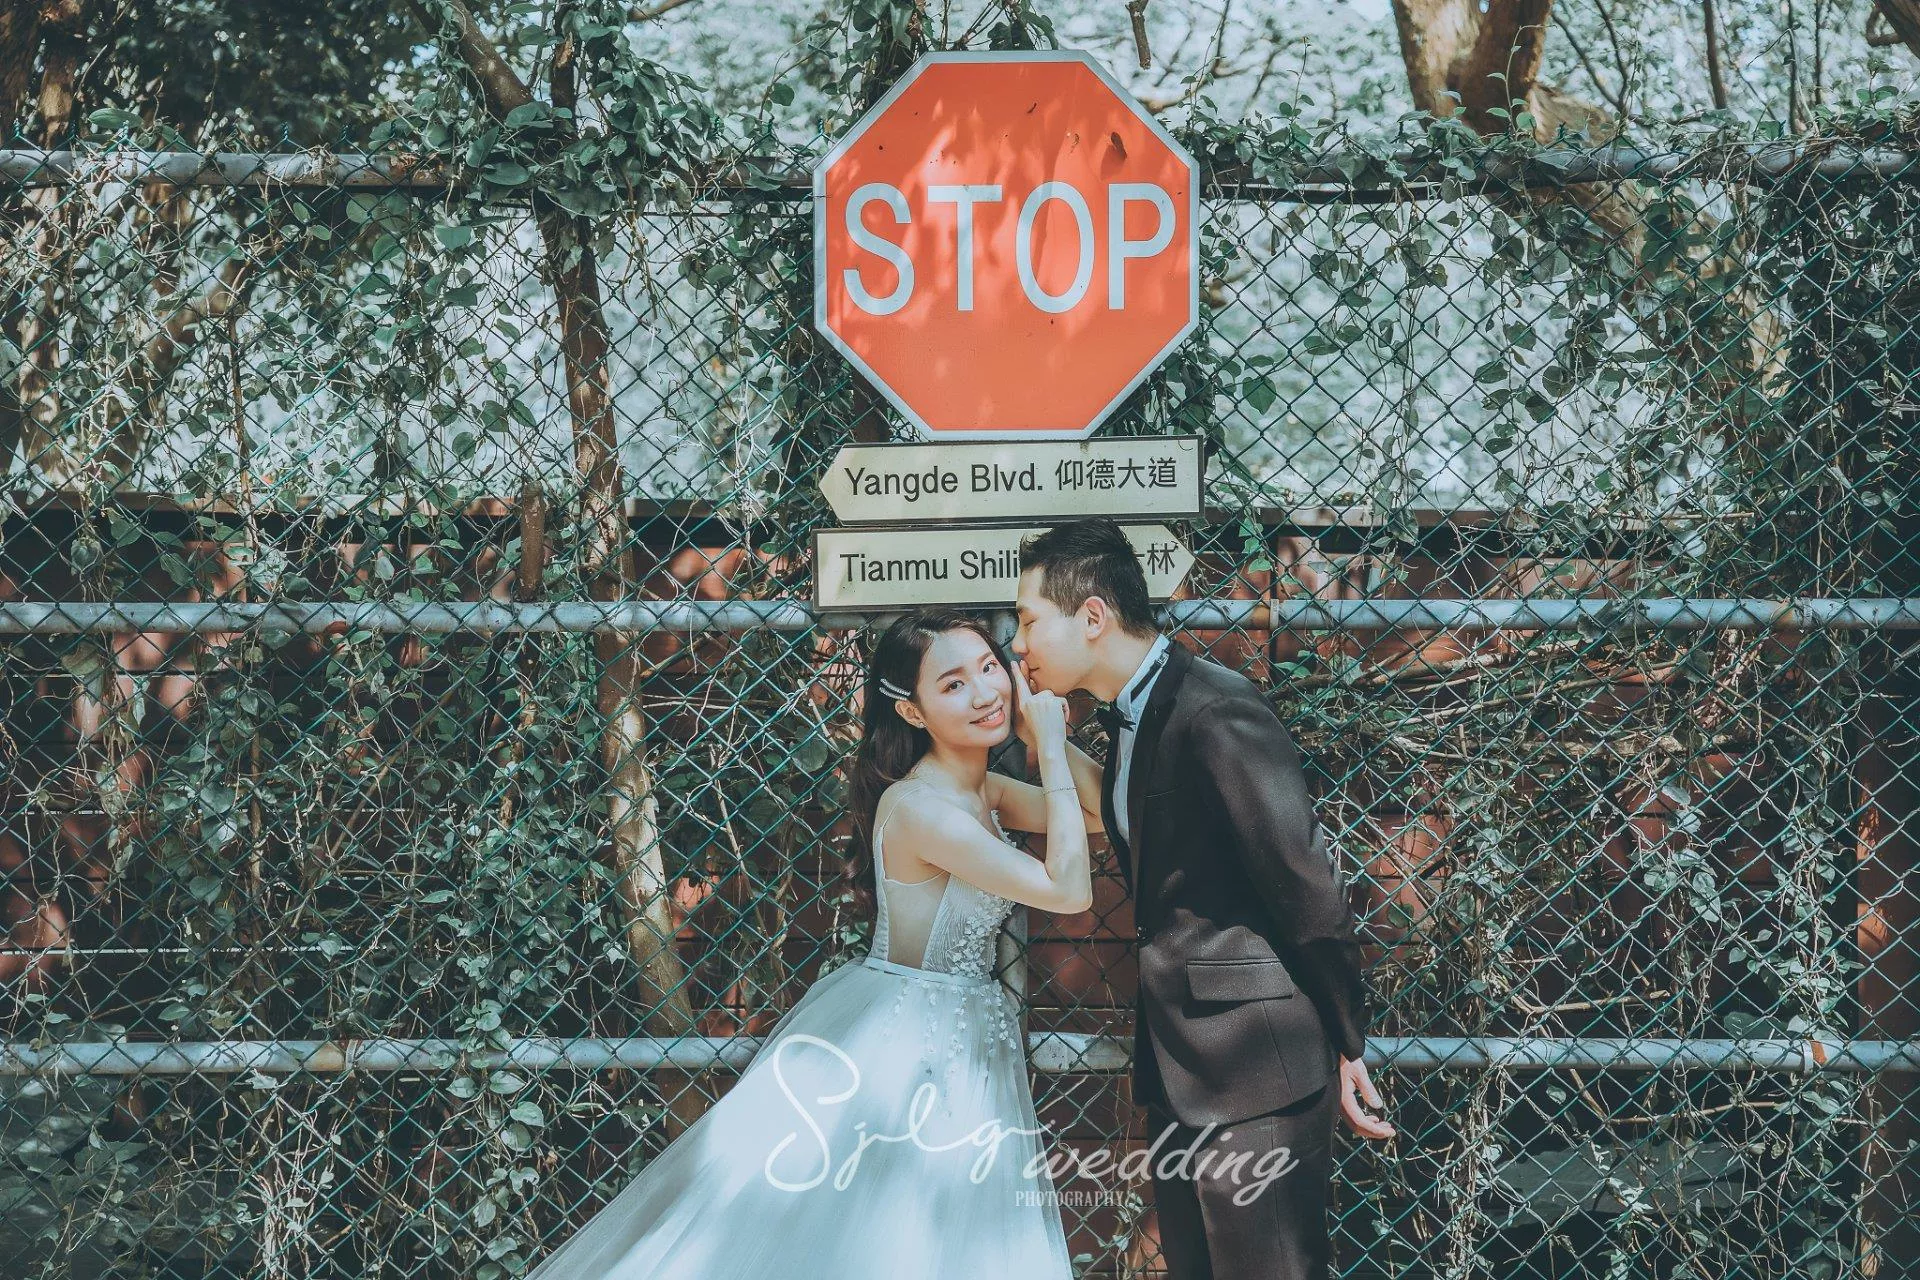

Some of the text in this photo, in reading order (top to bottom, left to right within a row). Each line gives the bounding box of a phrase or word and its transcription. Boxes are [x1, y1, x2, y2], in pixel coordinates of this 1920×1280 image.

[843, 181, 1176, 316] STOP
[845, 457, 1178, 502] Yangde Blvd. 仰德大道
[840, 552, 948, 582] Tianmu
[960, 550, 1018, 580] Shili
